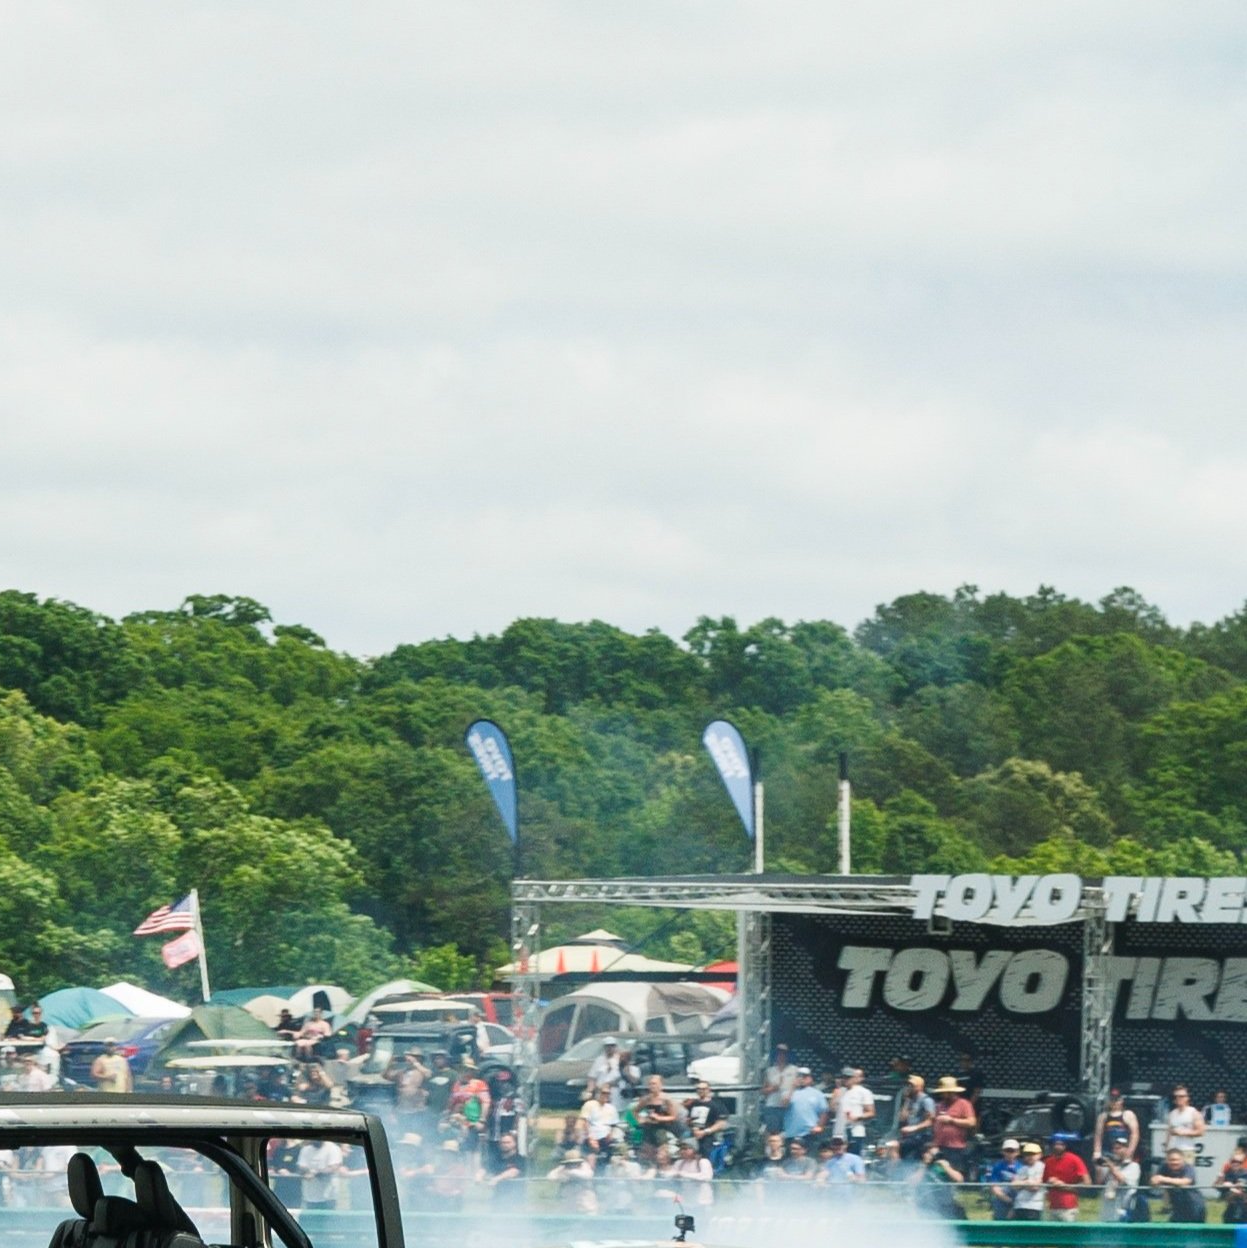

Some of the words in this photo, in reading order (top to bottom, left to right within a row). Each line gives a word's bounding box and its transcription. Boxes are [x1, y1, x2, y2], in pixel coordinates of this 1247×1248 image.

[909, 873, 1083, 921] TOYO
[1103, 876, 1247, 924] TIRE
[838, 945, 1069, 1013] TOYO
